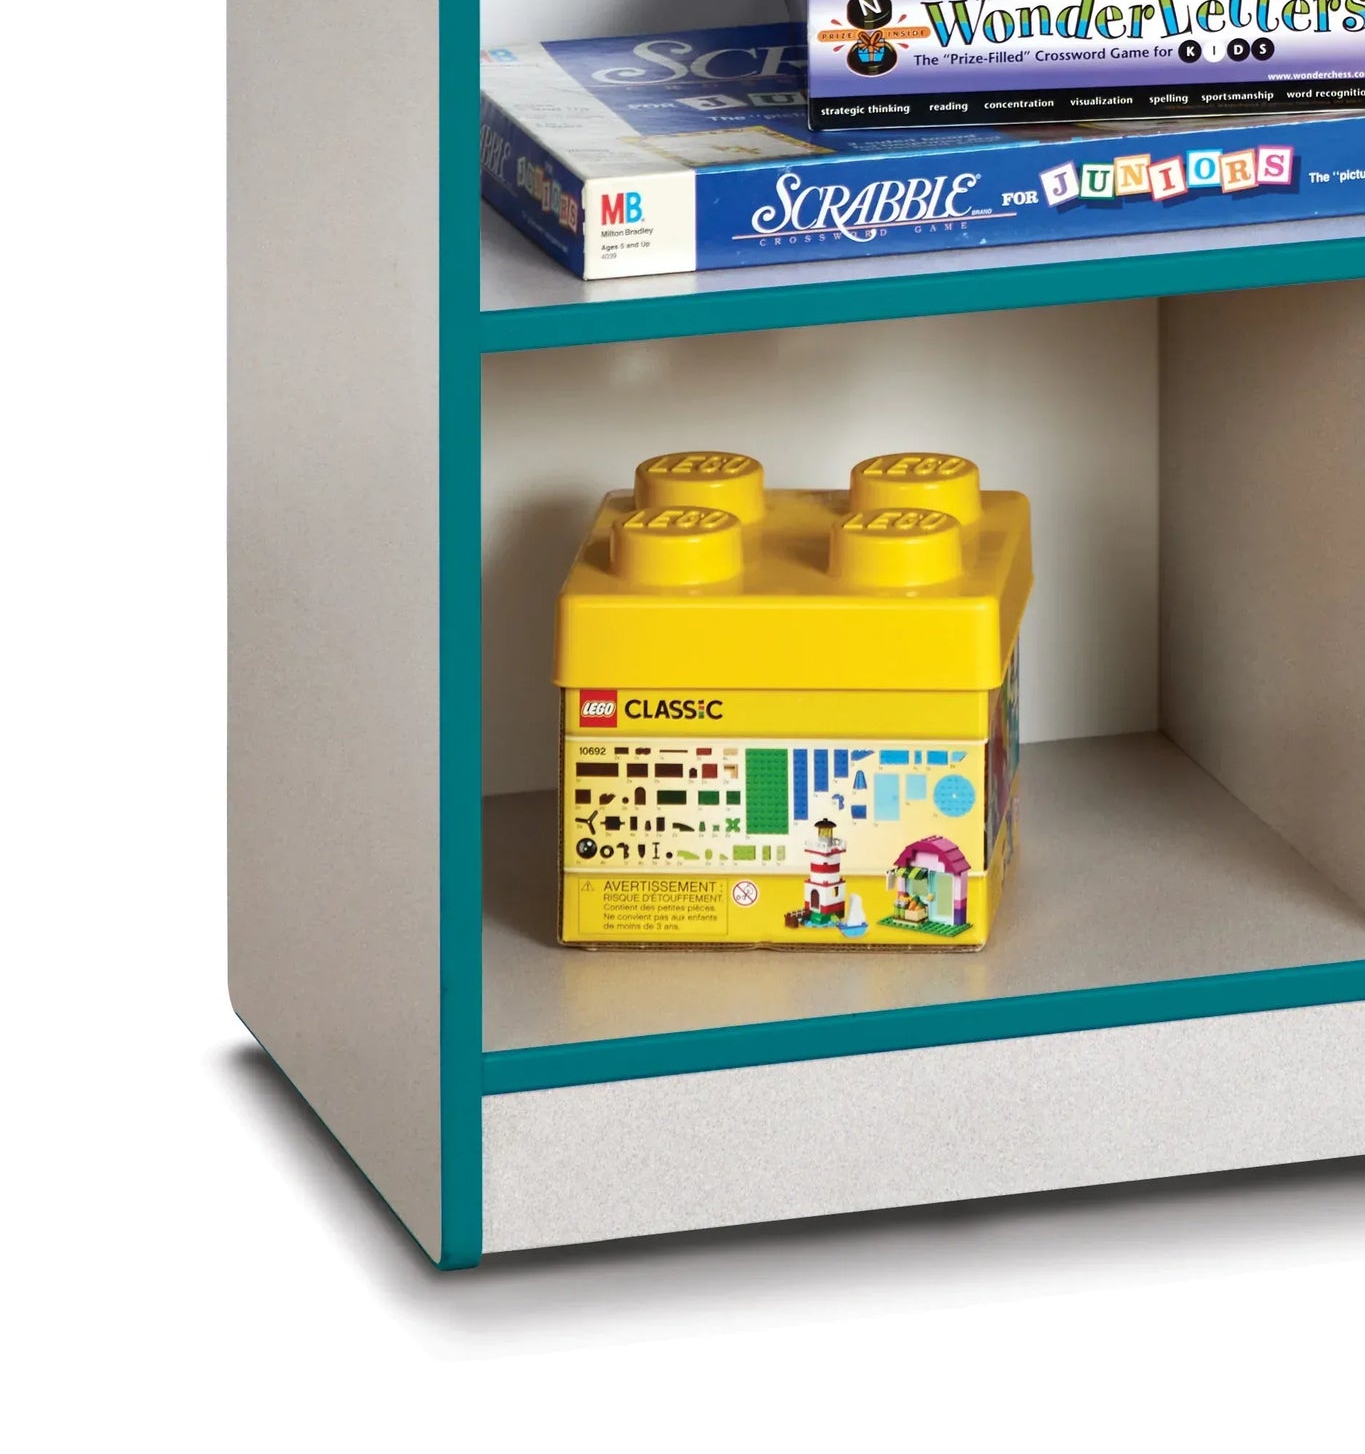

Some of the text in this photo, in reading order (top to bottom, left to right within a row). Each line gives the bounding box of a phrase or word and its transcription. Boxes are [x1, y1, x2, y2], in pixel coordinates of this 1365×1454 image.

[822, 29, 925, 40] PRIZE INSIDE
[913, 41, 1271, 66] The "Prize-Filled" Crossword Game for KIDS
[821, 106, 865, 117] strategic
[868, 104, 910, 116] thinking
[929, 102, 968, 114] reading
[984, 99, 1054, 109] concentration
[1070, 95, 1133, 106] visualization
[1150, 94, 1188, 105] spelling
[1201, 91, 1274, 102] sportsmanship
[1286, 90, 1314, 99] word
[1002, 149, 1290, 207] FOR JUNIORS
[1308, 172, 1330, 184] The
[601, 192, 642, 226] MB
[751, 172, 979, 242] SCRABBLE
[971, 208, 992, 216] BRAND
[601, 227, 654, 238] Milton Bradley
[760, 222, 967, 247] CROSSWORD GAME
[601, 244, 618, 252] Ages
[648, 455, 751, 474] LEGO
[863, 457, 966, 475] LEGO
[624, 510, 729, 529] LEGO
[843, 512, 947, 530] LEGO
[582, 701, 616, 717] LEGO
[579, 747, 606, 756] 10692
[604, 881, 716, 892] AVERTISSEMENT
[604, 894, 639, 903] RISQUE
[658, 904, 685, 913] petites
[604, 913, 615, 921] Ne
[617, 913, 651, 921] convient
[653, 914, 669, 922] pas
[688, 913, 717, 921] enfants
